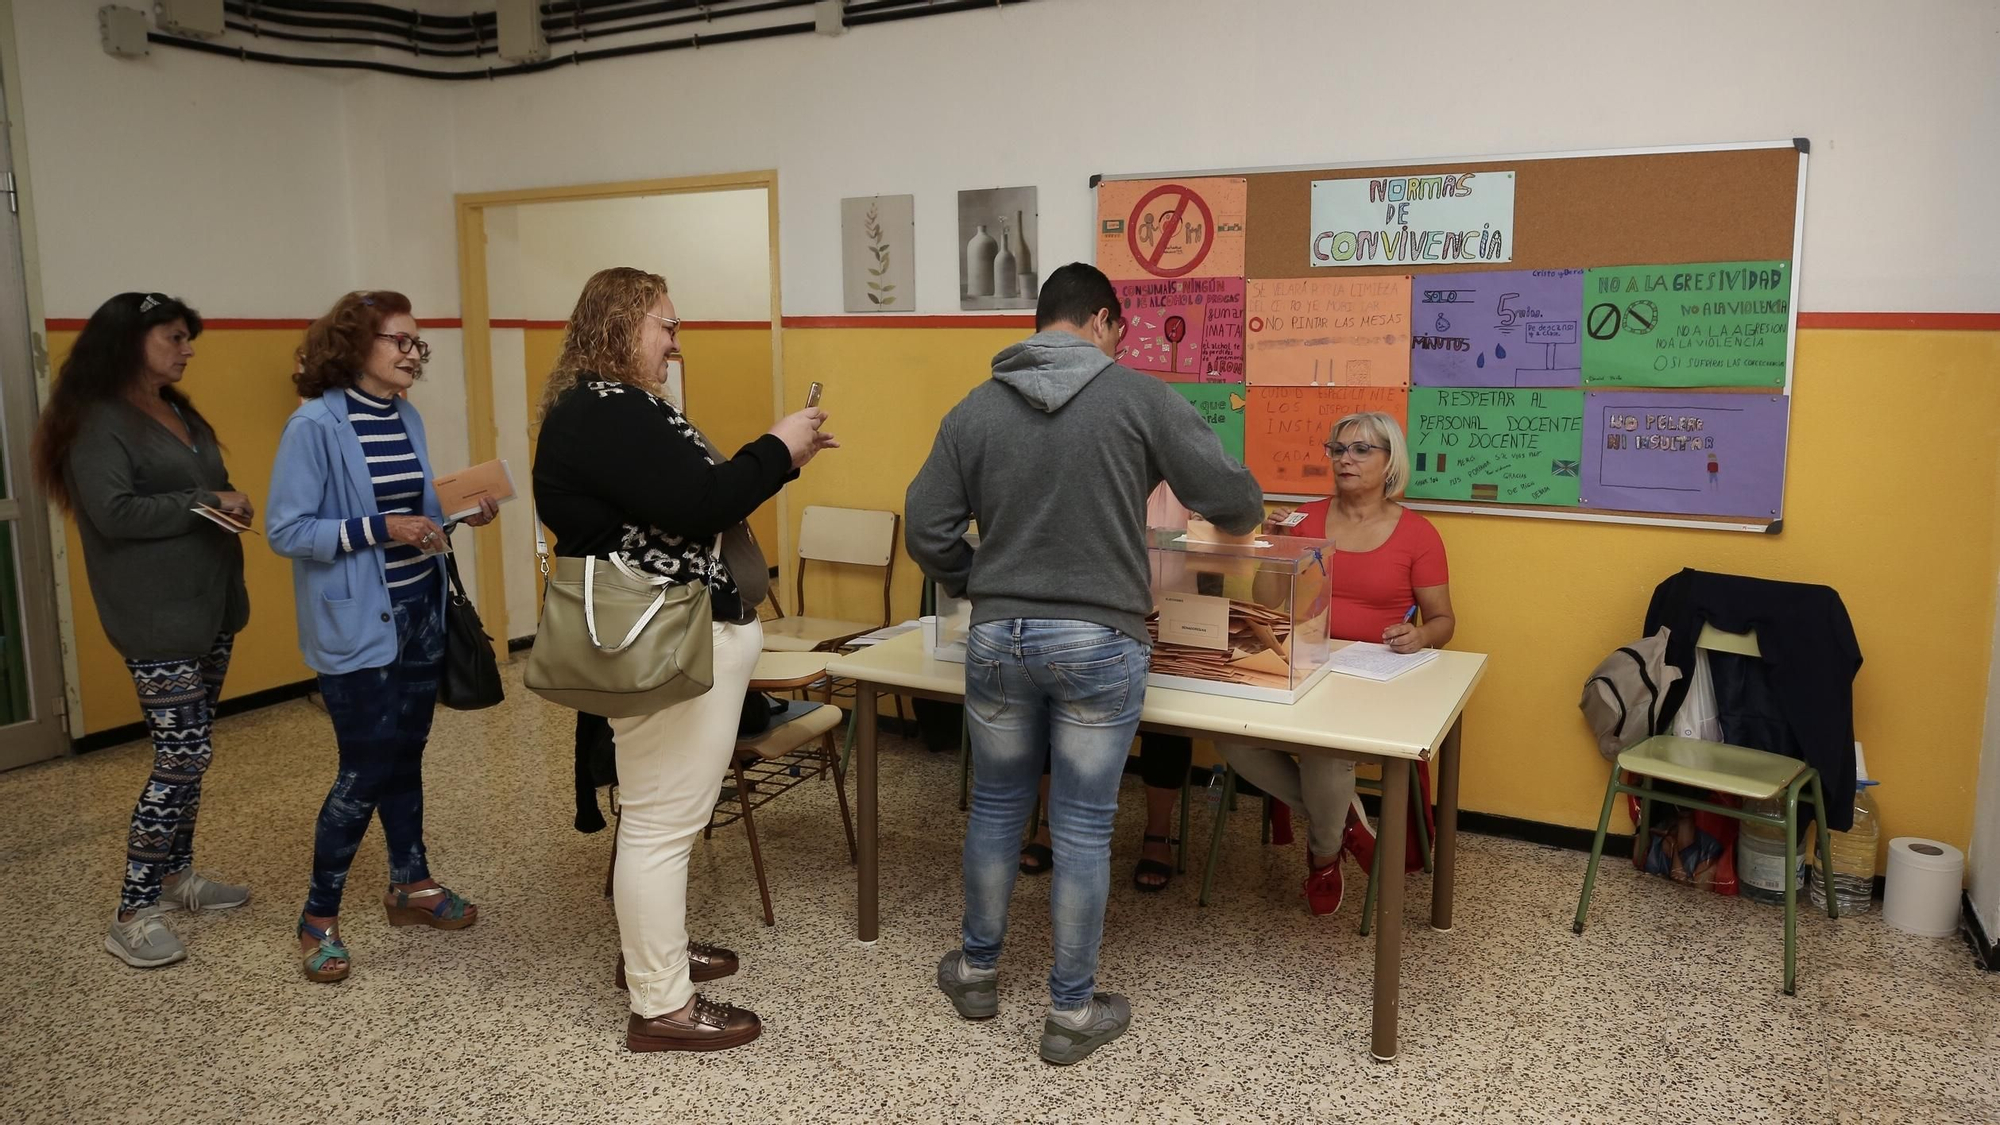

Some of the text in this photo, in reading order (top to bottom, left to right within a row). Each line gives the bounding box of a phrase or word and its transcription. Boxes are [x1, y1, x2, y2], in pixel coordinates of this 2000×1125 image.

[1370, 173, 1475, 203] NORMAS
[1386, 202, 1410, 225] DE
[1313, 223, 1502, 261] CONVIVENCIA
[1599, 277, 1620, 293] NO
[1626, 276, 1638, 292] A
[1423, 290, 1457, 303] SOLO
[1681, 305, 1699, 316] NO
[1265, 313, 1402, 331] NO PINTAR LAS MESAS
[1676, 325, 1690, 337] NO
[1411, 333, 1471, 352] MINUTOS
[1656, 337, 1667, 348] NO
[1200, 401, 1226, 414] que
[1266, 402, 1301, 413] LOS
[1437, 390, 1548, 409] RESPETAR AL
[1419, 414, 1582, 432] PERSONAL DOCENTE
[1609, 414, 1639, 432] NO
[1418, 432, 1539, 449] Y NO DOCENTE
[1606, 434, 1627, 450] NI
[1273, 451, 1311, 463] CADA
